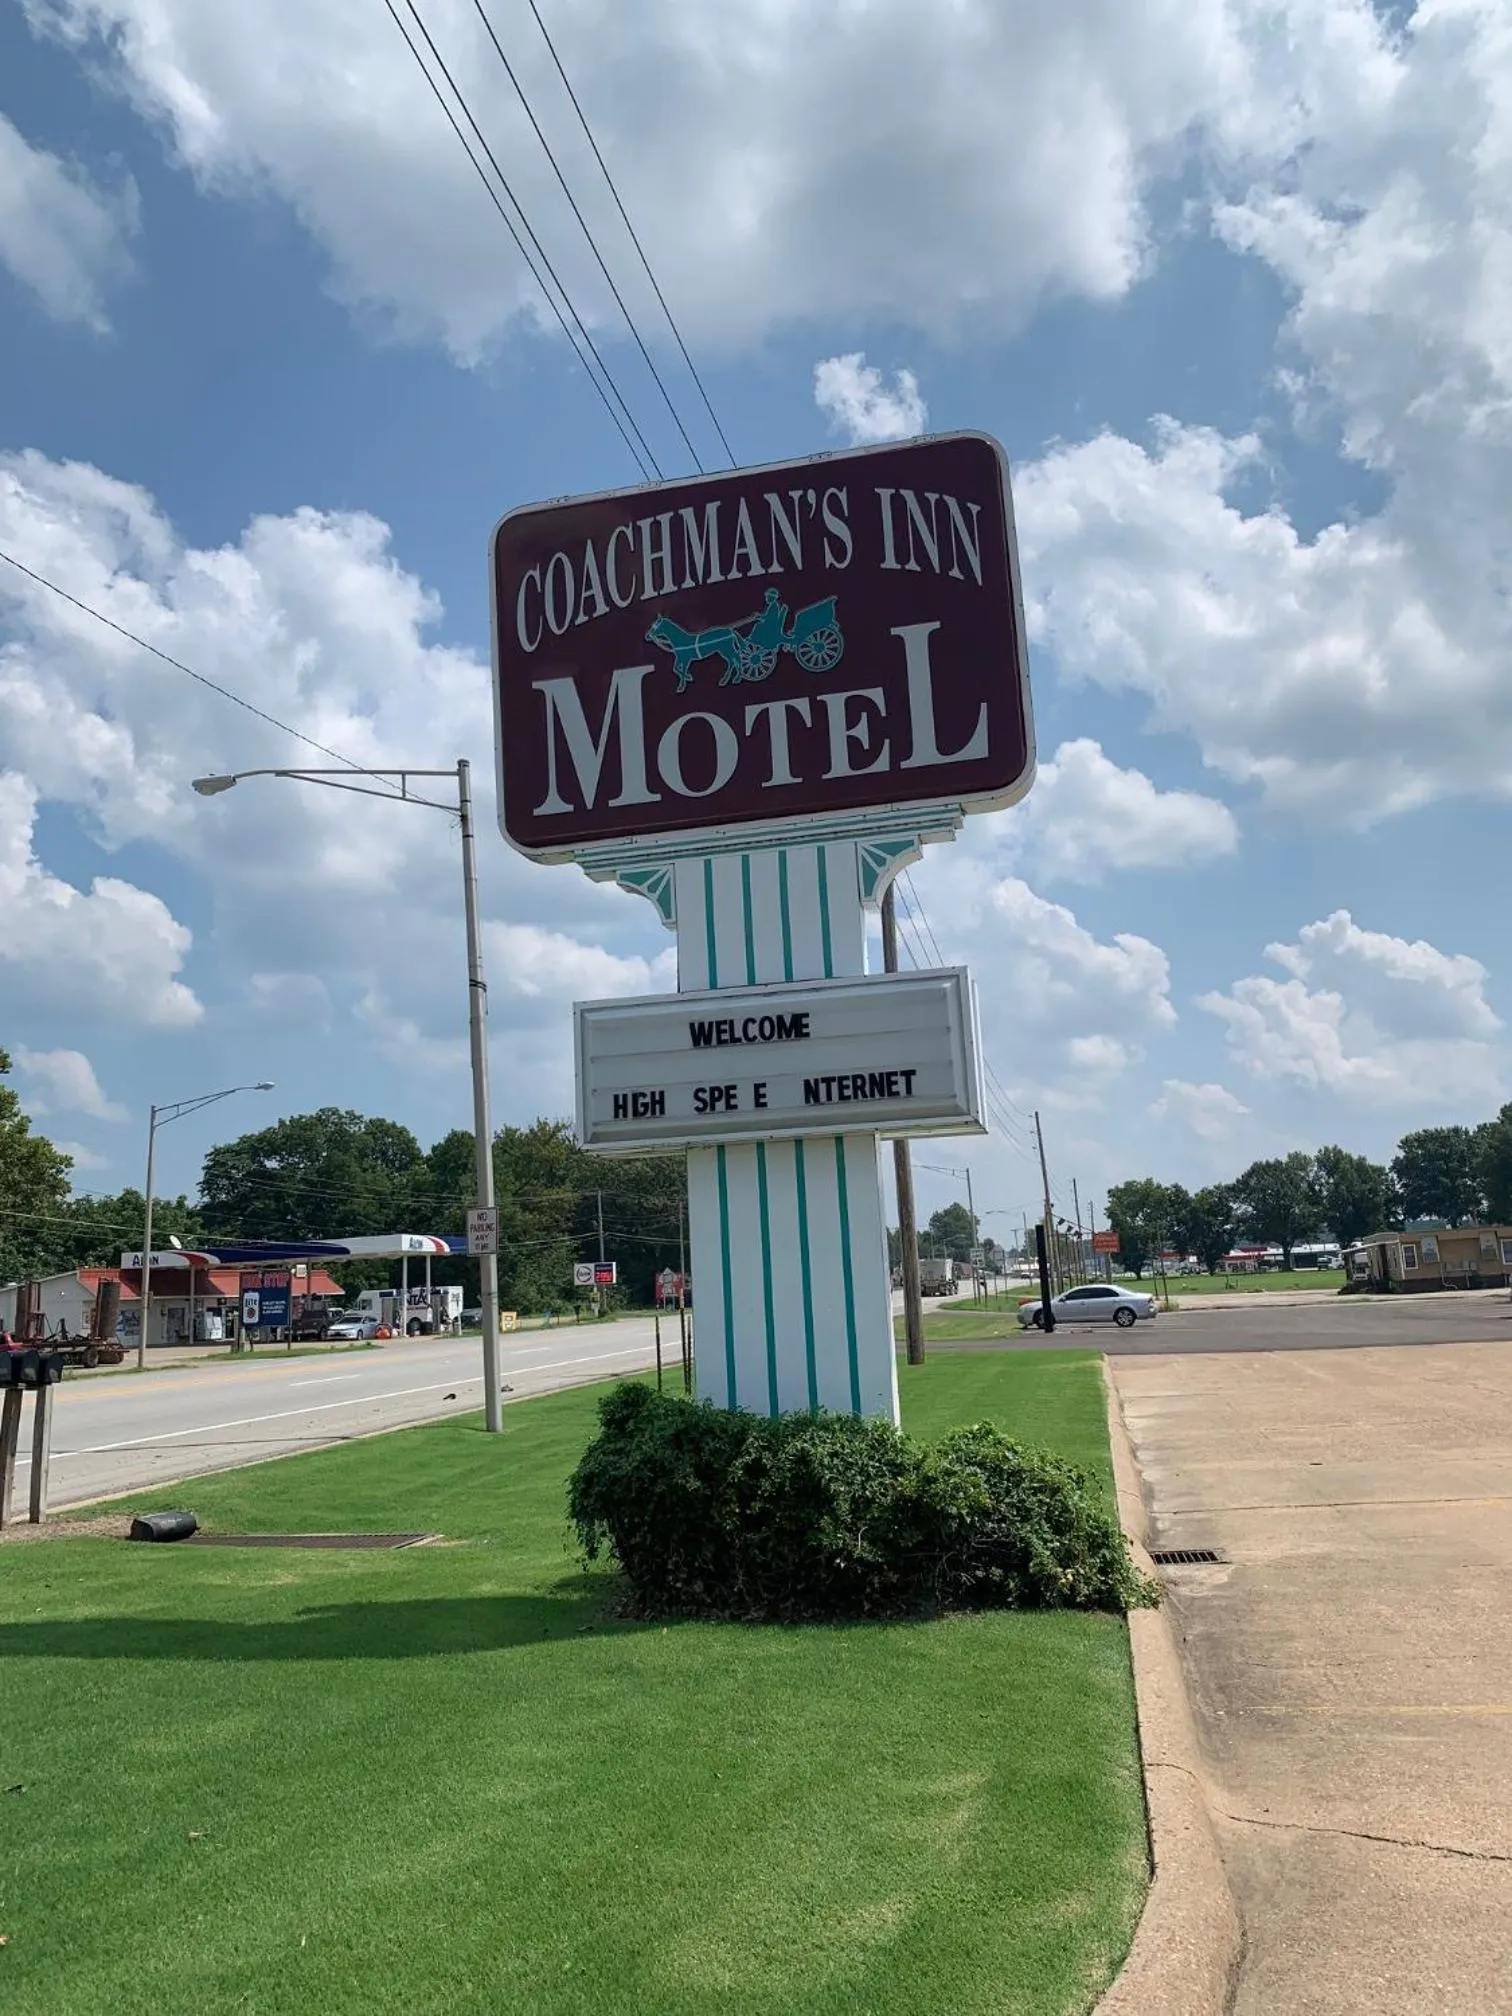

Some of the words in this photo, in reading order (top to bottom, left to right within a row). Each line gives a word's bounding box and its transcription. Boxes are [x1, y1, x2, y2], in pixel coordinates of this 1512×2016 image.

[516, 486, 854, 654] COACHMAN'S
[874, 487, 984, 588] INN
[531, 620, 991, 818] MOTEL
[689, 1012, 810, 1048] WELCOME
[803, 1069, 917, 1105] NTERNET
[132, 1254, 160, 1267] AN
